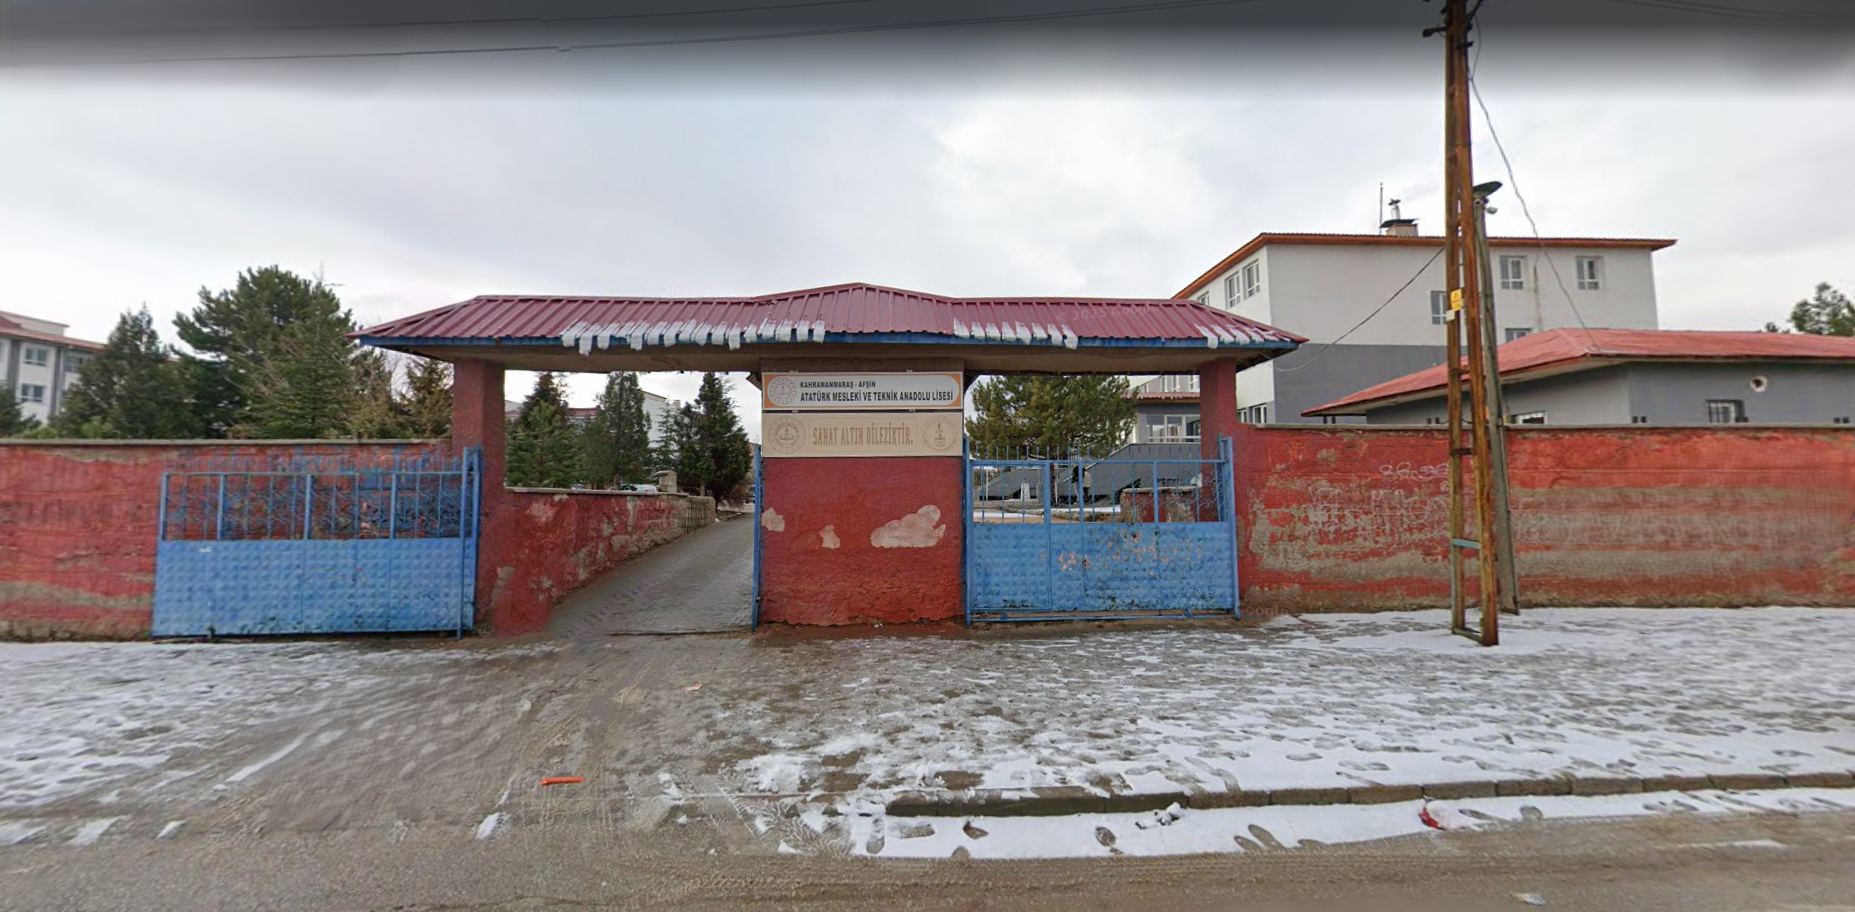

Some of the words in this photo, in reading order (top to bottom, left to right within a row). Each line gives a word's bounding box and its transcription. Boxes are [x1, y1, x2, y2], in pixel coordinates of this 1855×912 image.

[800, 381, 854, 389] KAHRAMANMARAŞ
[858, 380, 876, 389] AFŞİN
[800, 390, 831, 402] ATATÜRK
[832, 390, 861, 402] MESLEKİ
[863, 391, 872, 401] VE
[873, 389, 898, 401] TEKNİK
[899, 391, 931, 401] ANADOLU
[932, 389, 953, 401] LİSESİ
